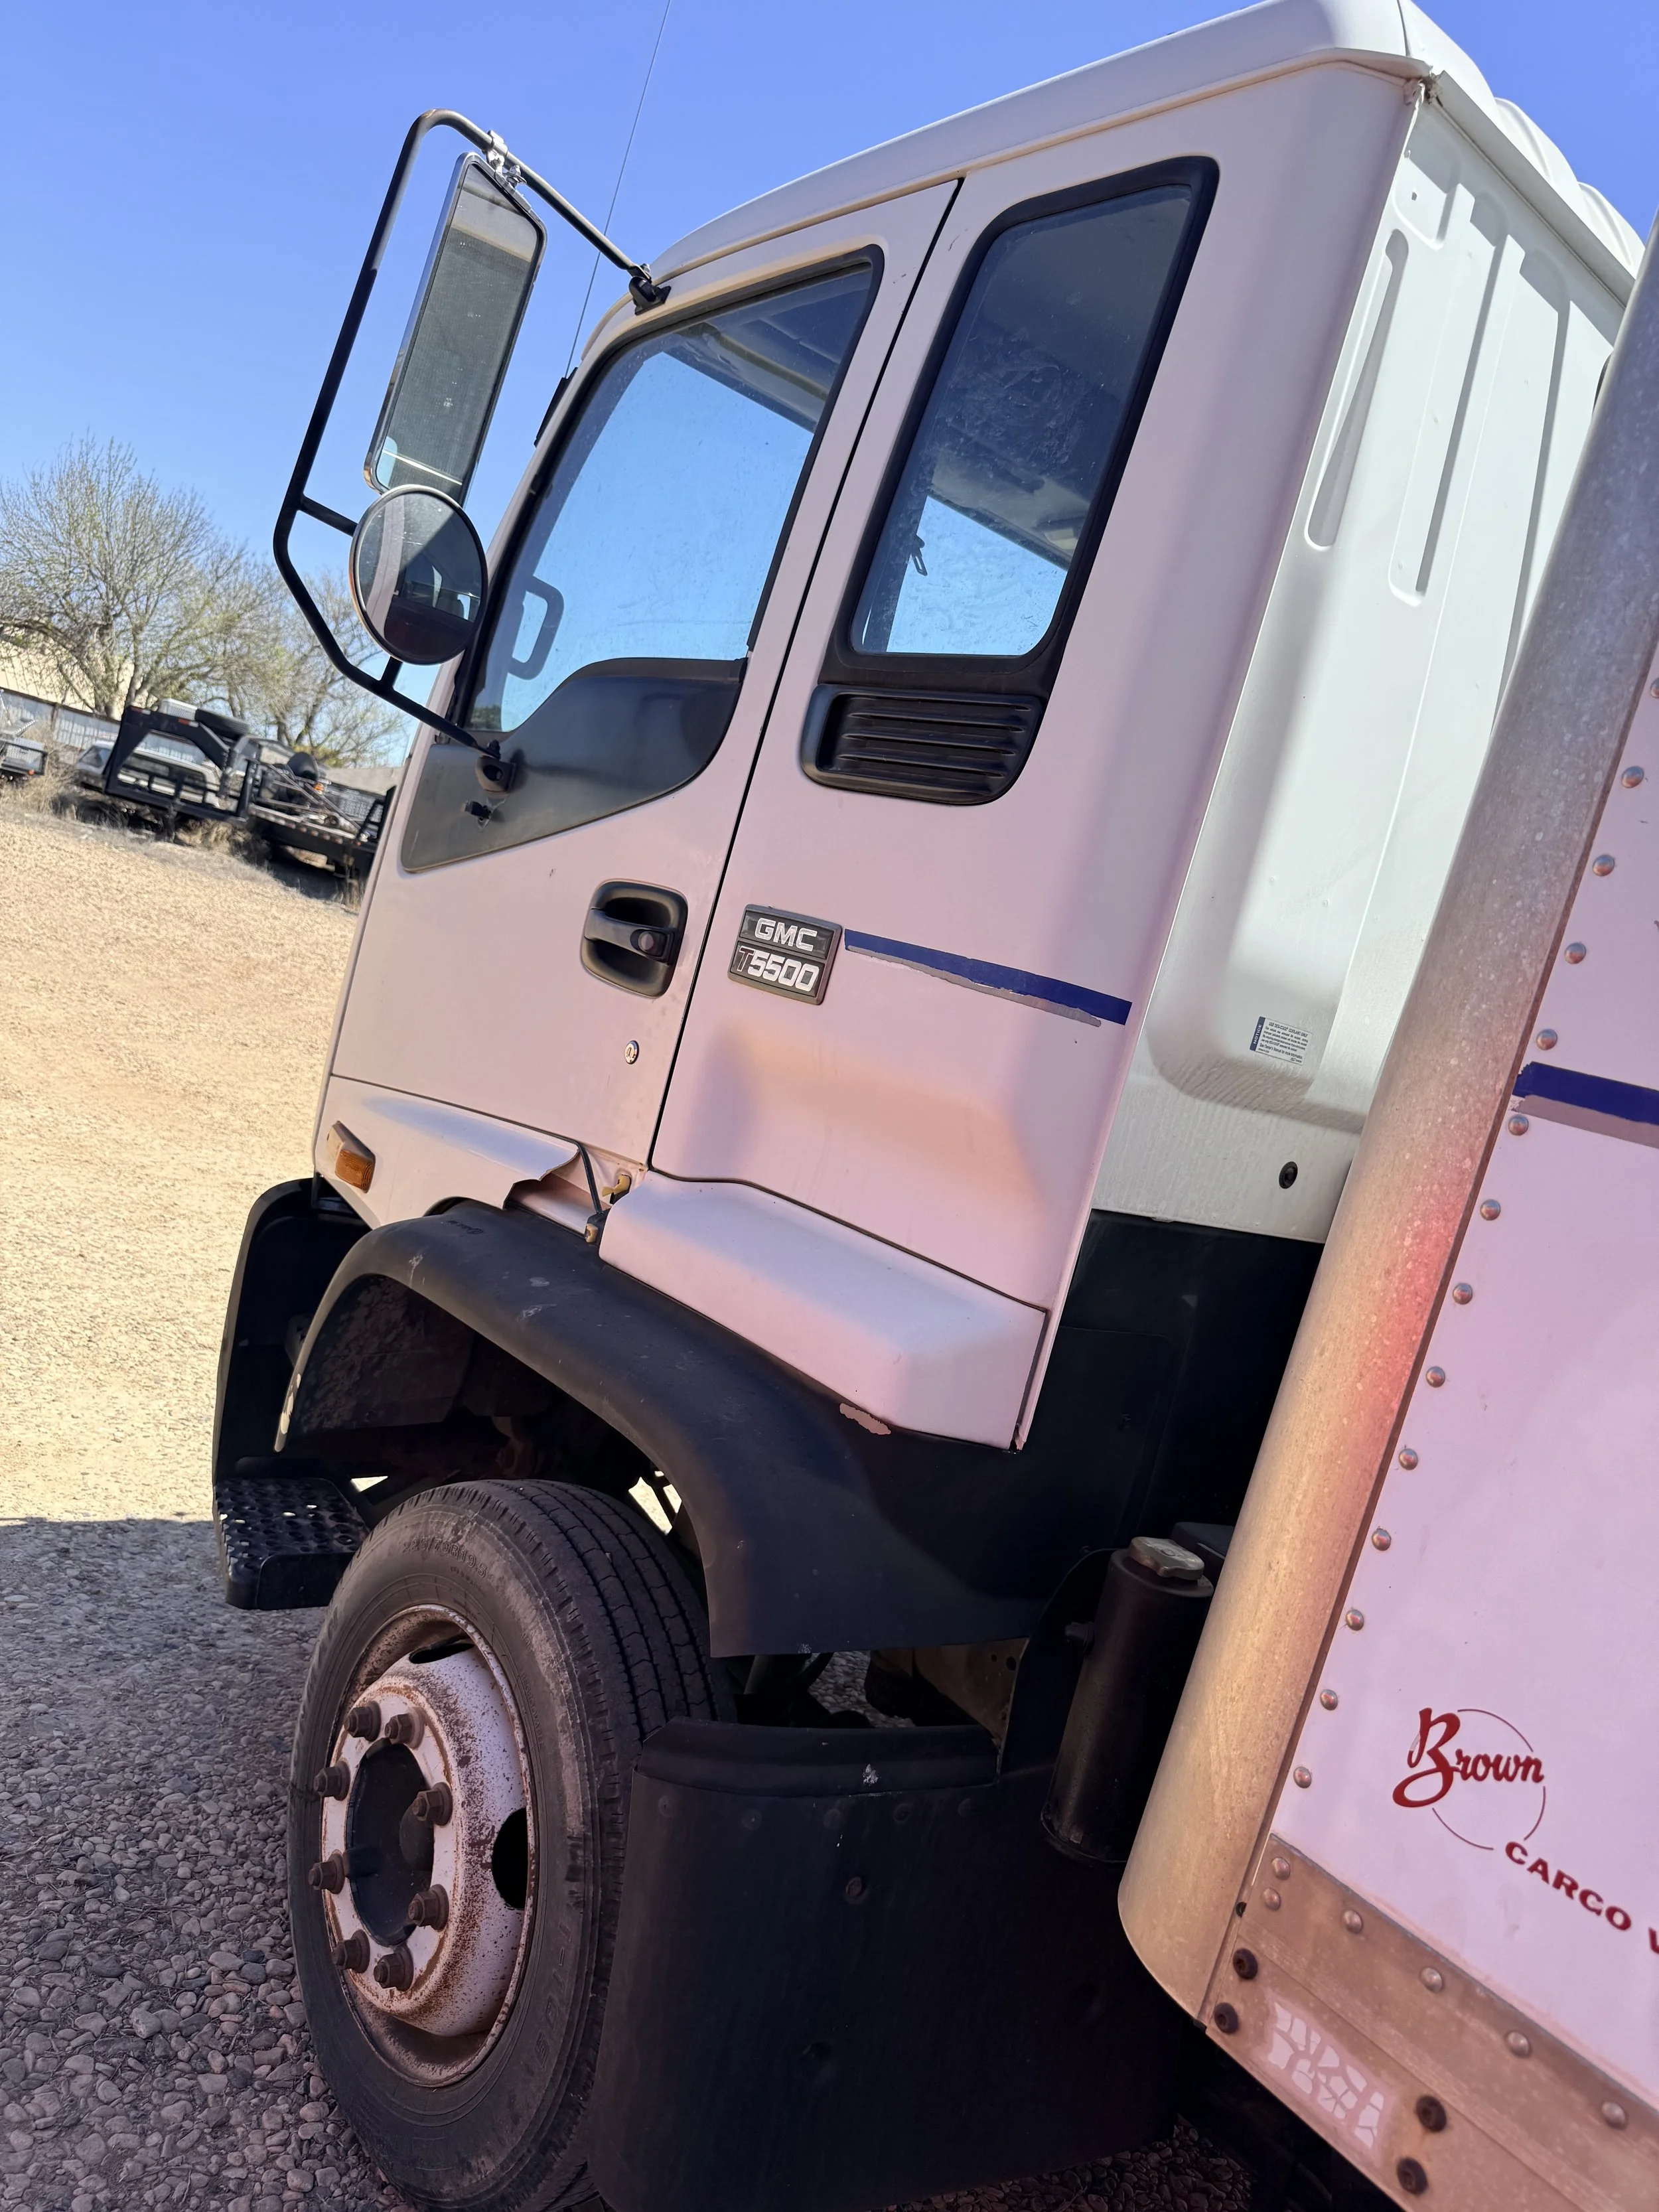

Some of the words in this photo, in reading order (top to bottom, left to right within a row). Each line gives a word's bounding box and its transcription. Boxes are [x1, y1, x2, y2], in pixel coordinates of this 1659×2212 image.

[755, 917, 818, 952] GMC
[737, 945, 820, 992] T5500
[1253, 1024, 1262, 1045] NOTICE
[1392, 1708, 1546, 1808] Brown
[1505, 1841, 1632, 1932] CARGO
